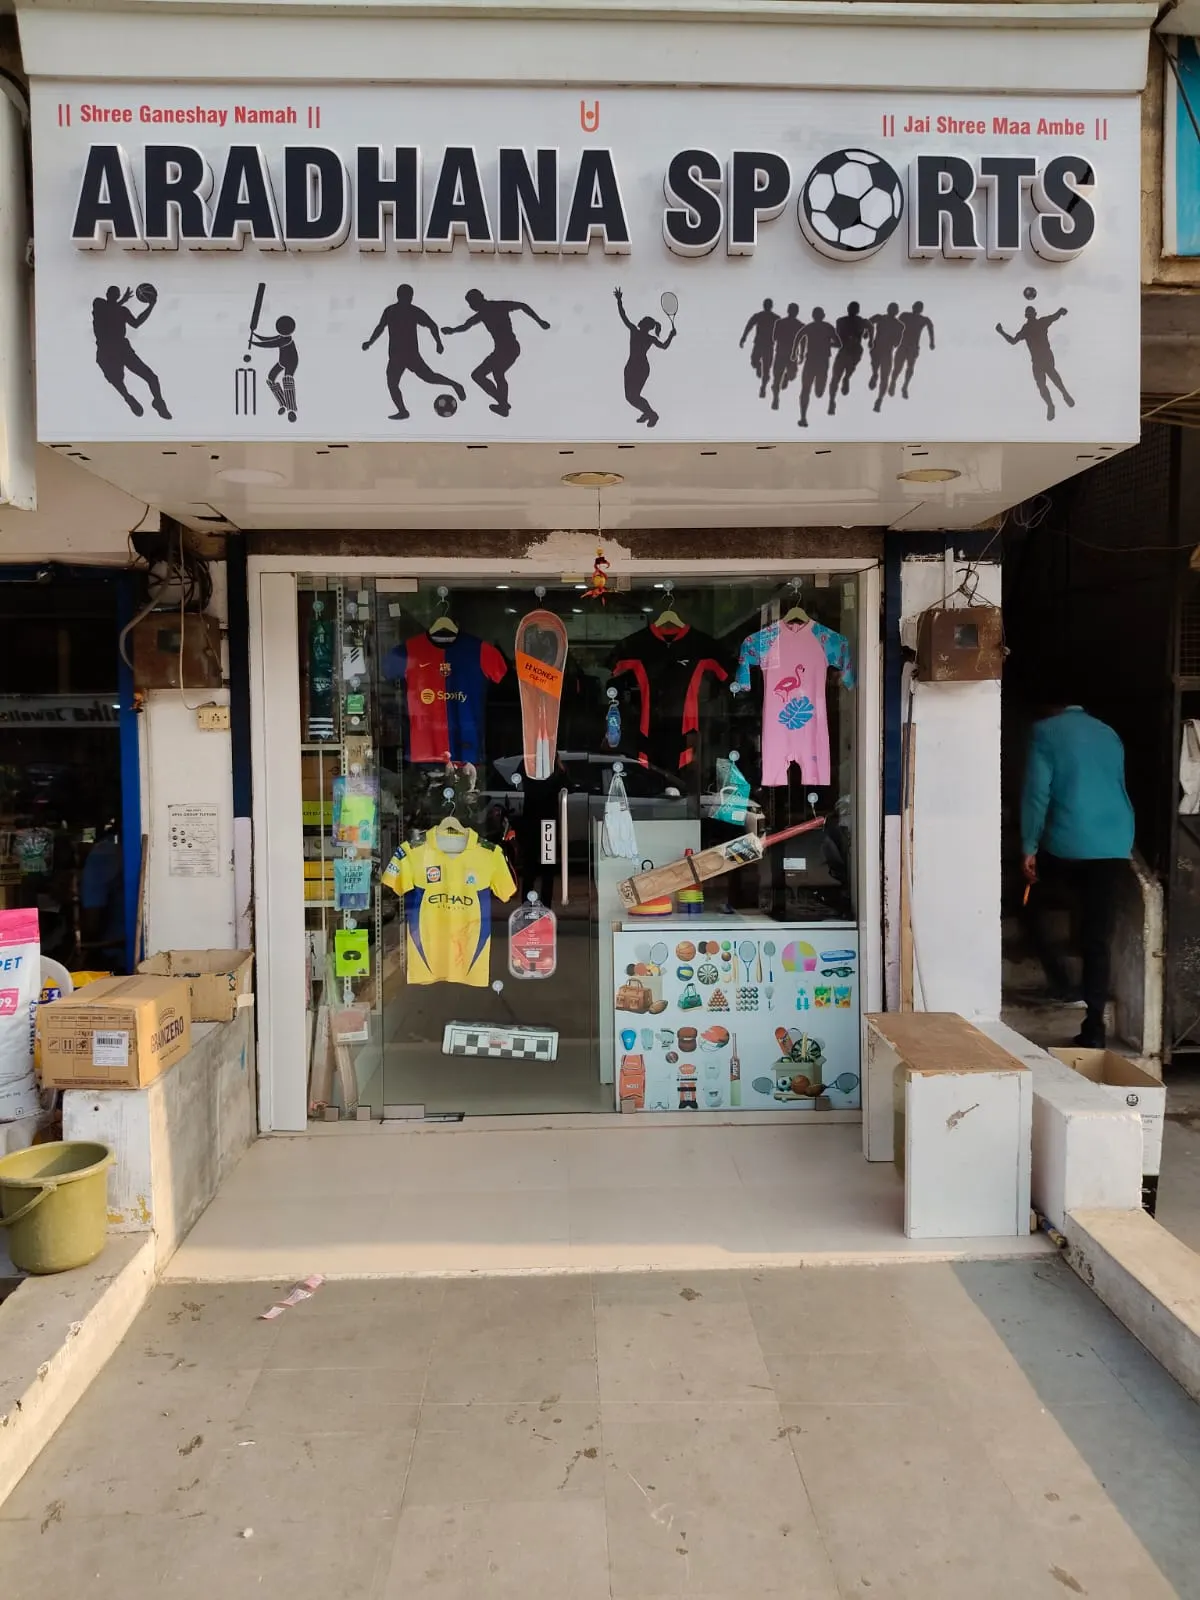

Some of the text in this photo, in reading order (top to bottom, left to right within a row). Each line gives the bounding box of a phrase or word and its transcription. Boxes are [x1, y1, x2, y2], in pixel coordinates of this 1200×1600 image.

[80, 104, 133, 123] Shree
[139, 104, 228, 127] Ganeshay
[235, 105, 297, 124] Namah
[903, 115, 930, 133] Jai
[937, 116, 986, 134] Shree
[992, 117, 1031, 135] Maa
[1037, 118, 1085, 136] Ambe
[72, 144, 1097, 260] ARADHANA SPORTS
[544, 823, 552, 861] PULL
